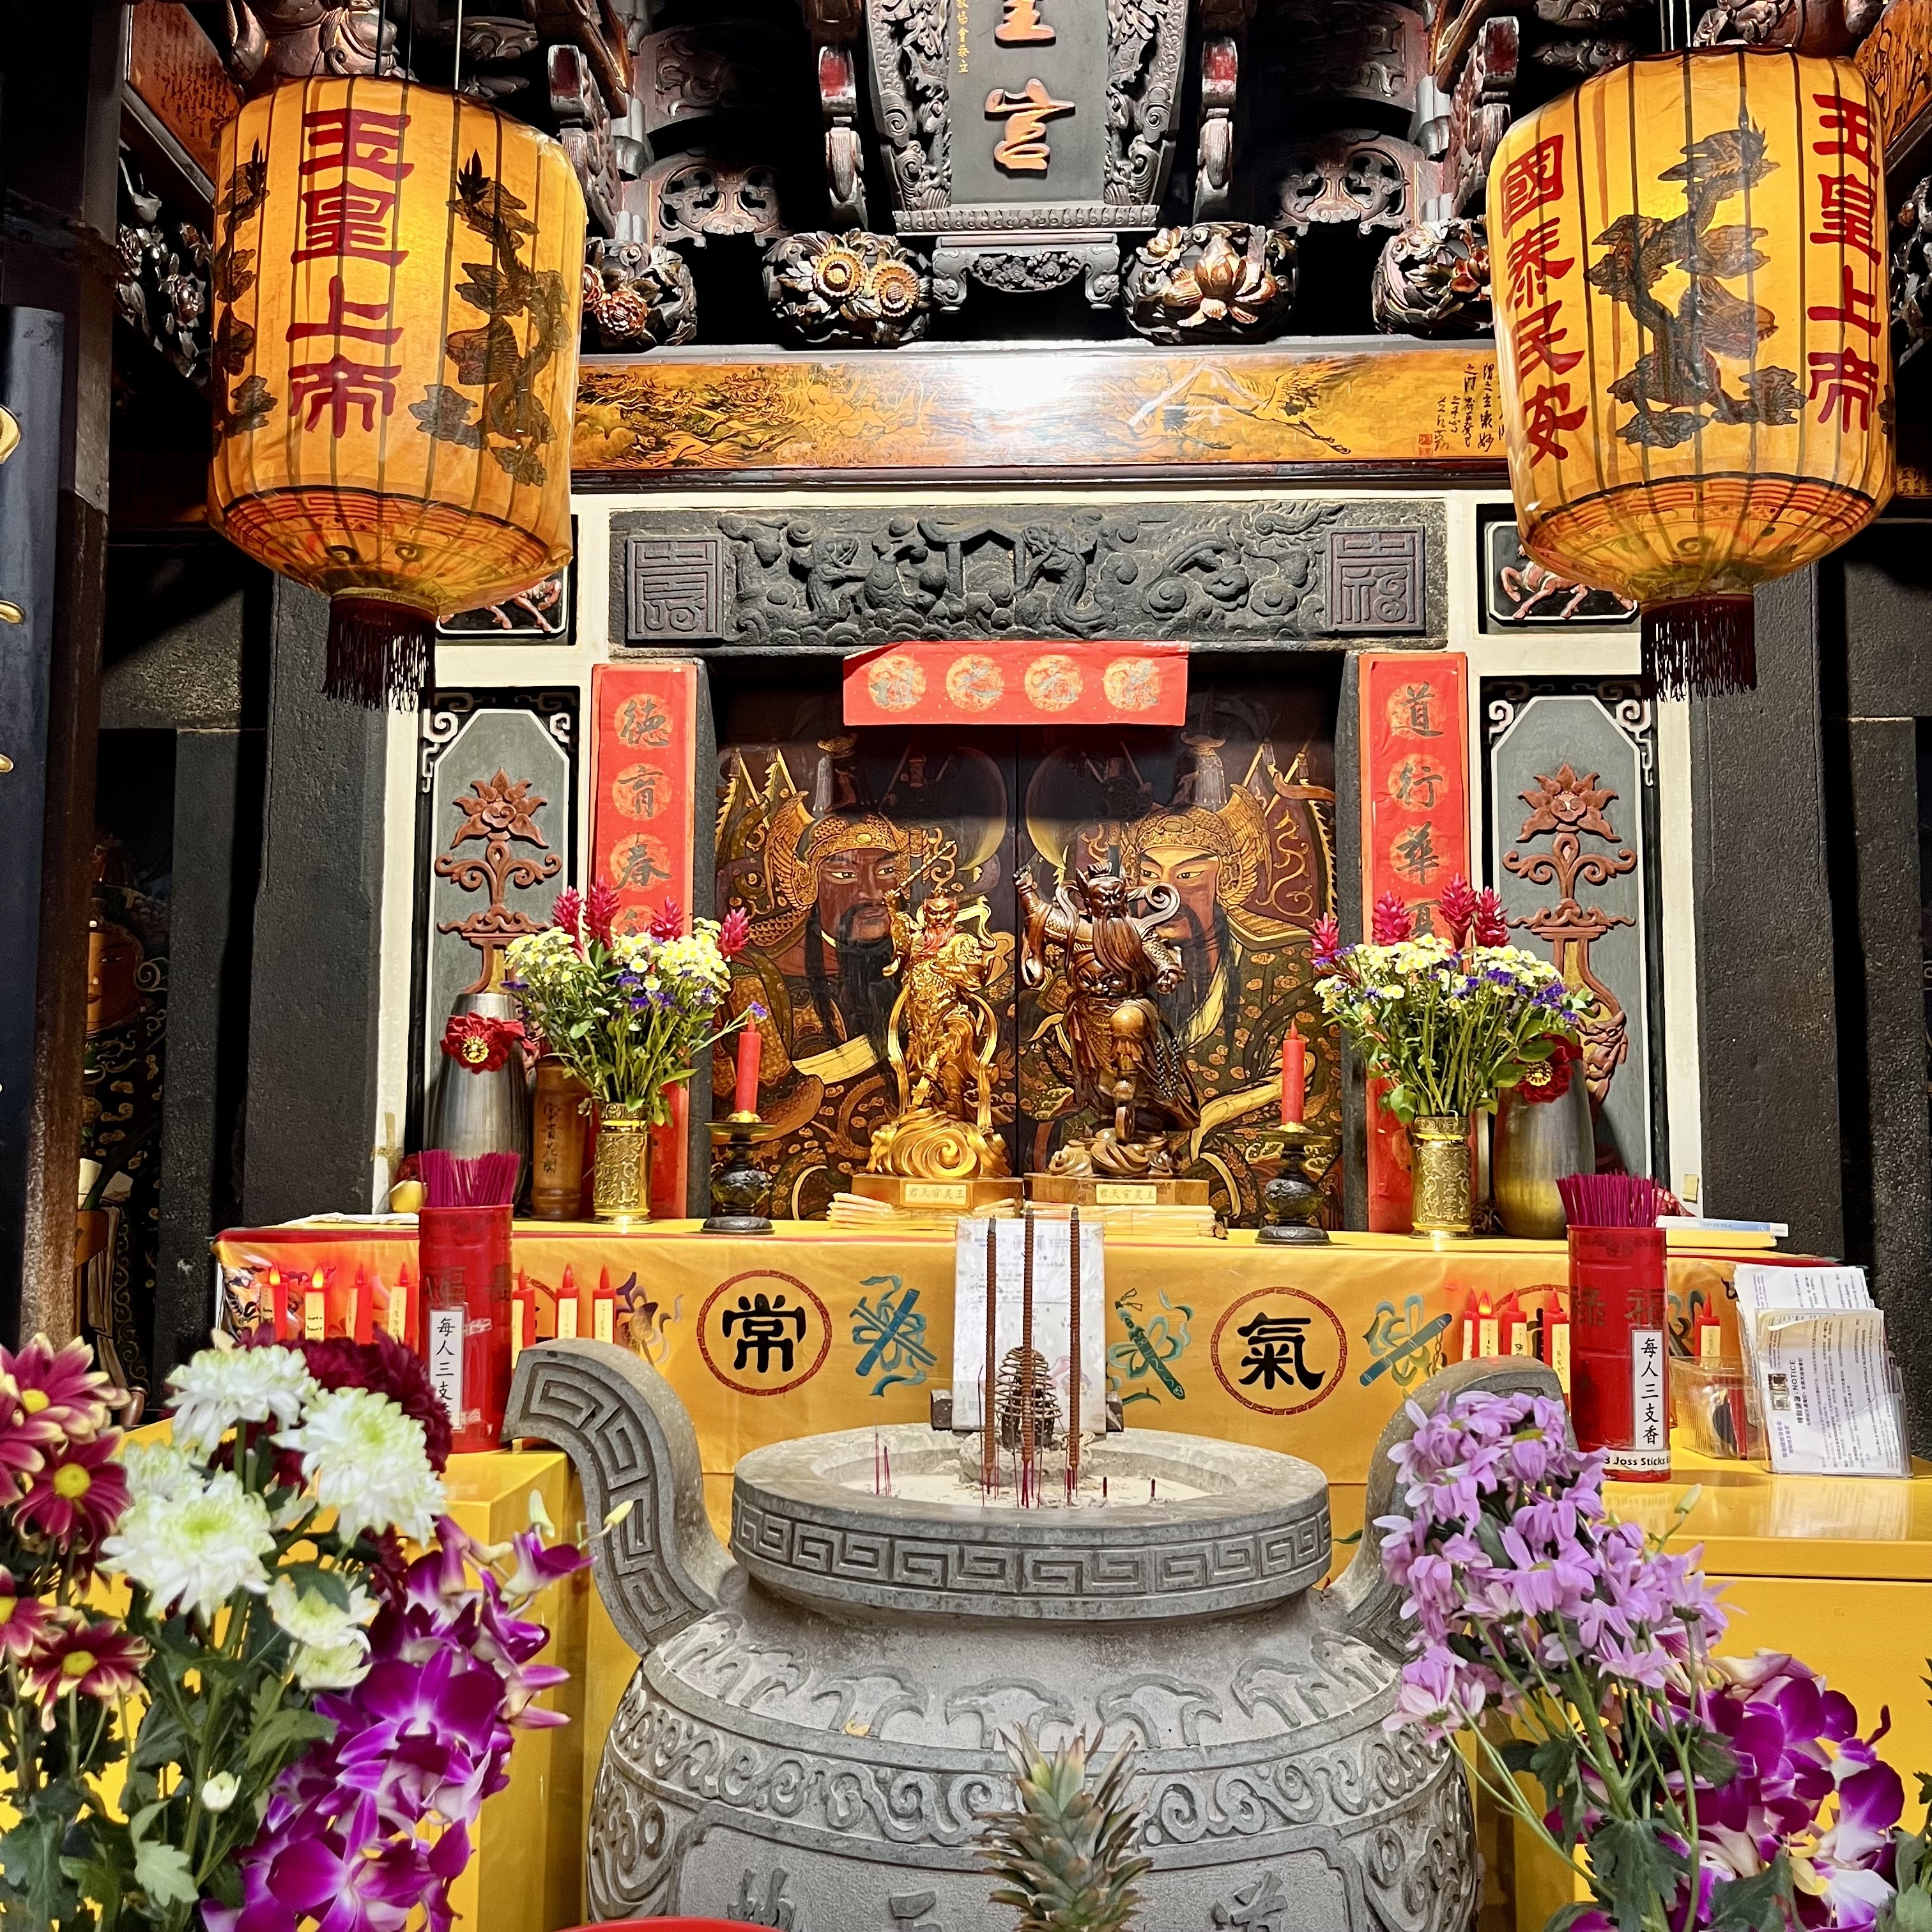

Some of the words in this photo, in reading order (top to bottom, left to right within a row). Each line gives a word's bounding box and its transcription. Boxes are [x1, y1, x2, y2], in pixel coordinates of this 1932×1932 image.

[287, 108, 414, 439] 玉皇上帝
[1500, 134, 1588, 468] 國泰民安
[1807, 94, 1882, 433] 玉皇上帝
[613, 697, 673, 935] 德育春
[436, 1316, 456, 1414] 每人三支
[722, 1292, 805, 1373] 常
[1236, 1312, 1326, 1390] 氣
[1790, 1360, 1798, 1390] NOTICE
[1640, 1337, 1660, 1446] 每人三支香
[1613, 1457, 1637, 1466] Joss
[1641, 1456, 1665, 1466] Sticks
